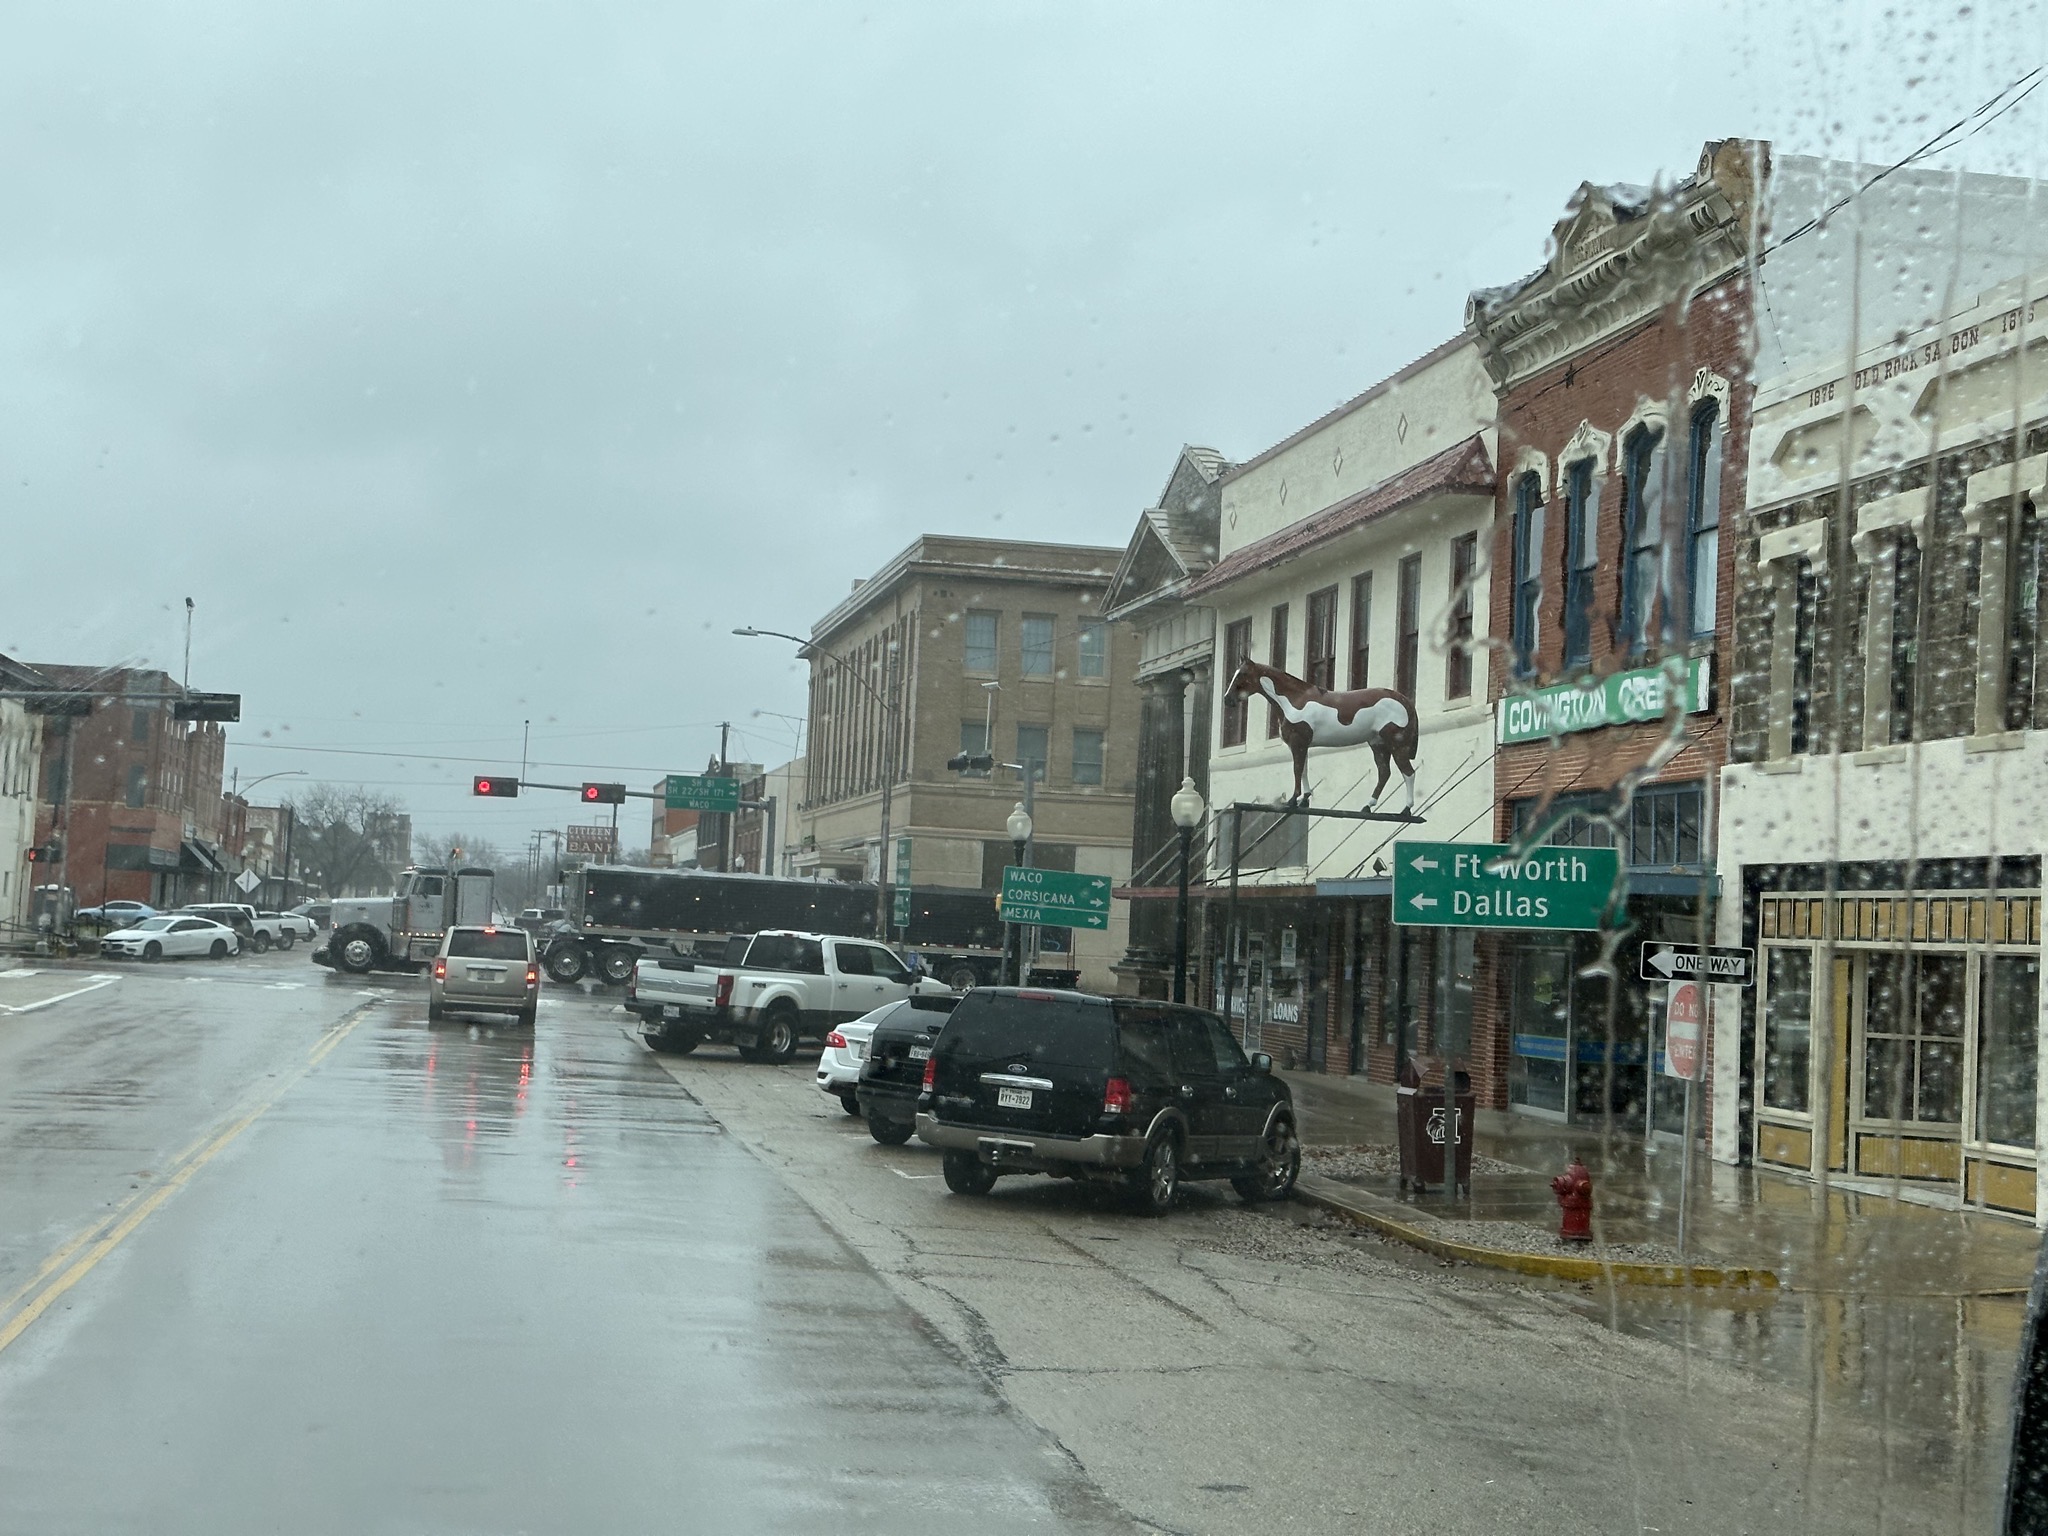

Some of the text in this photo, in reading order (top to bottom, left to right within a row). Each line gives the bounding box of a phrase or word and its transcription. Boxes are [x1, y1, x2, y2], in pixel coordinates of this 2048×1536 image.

[1854, 369, 1879, 390] OLD
[1884, 354, 1918, 379] ROCK
[1924, 328, 1979, 364] SAOON
[1509, 684, 1606, 735] COVINGTON
[692, 779, 702, 787] SH
[682, 787, 709, 796] 22/SH
[689, 801, 710, 809] WACO
[569, 827, 617, 836] CITIZEN
[1455, 854, 1587, 882] Ft Worth
[1010, 871, 1042, 883] WACO
[1008, 889, 1075, 904] CORSICANA
[1454, 890, 1548, 918] Dallas
[1005, 907, 1041, 920] MEXIA
[1675, 956, 1741, 973] ONE WAY
[1273, 1002, 1299, 1023] LOANS
[1674, 1002, 1699, 1018] DO NO
